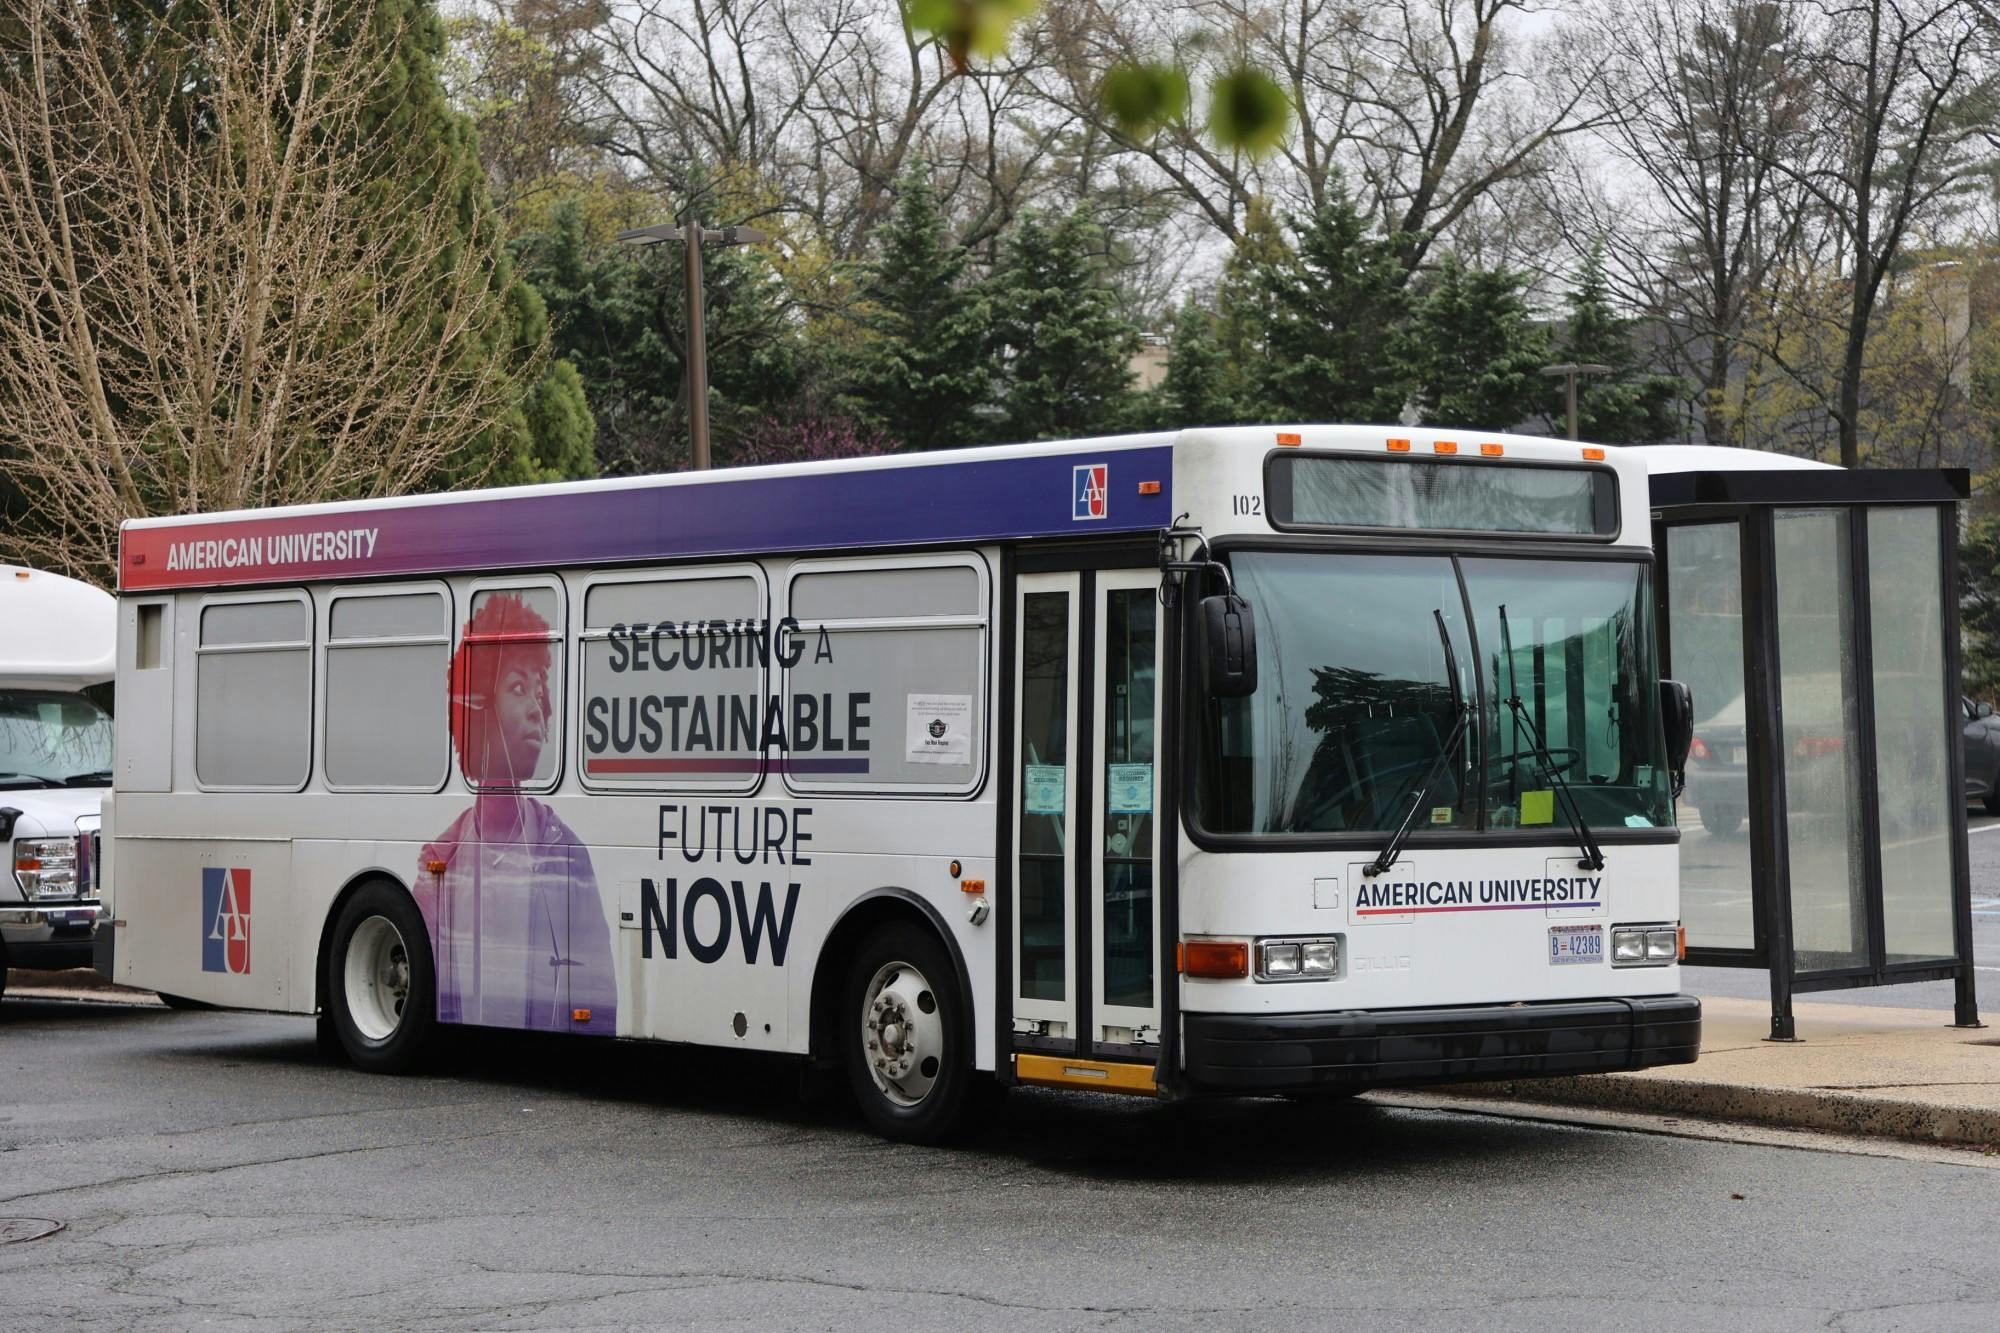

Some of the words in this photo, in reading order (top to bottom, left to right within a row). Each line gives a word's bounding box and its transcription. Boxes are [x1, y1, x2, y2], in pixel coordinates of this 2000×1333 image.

[1232, 495, 1261, 516] 102
[166, 536, 262, 572] AMERICAN
[267, 528, 379, 566] UNIVERSITY
[608, 617, 806, 673] SECURING
[814, 624, 834, 665] A
[585, 692, 871, 754] SUSTAINABLE
[658, 805, 813, 866] FUTURE
[1356, 880, 1473, 908] AMERICAN
[1479, 877, 1602, 904] UNIVERSITY
[640, 877, 802, 967] NOW
[1569, 935, 1601, 955] 42389
